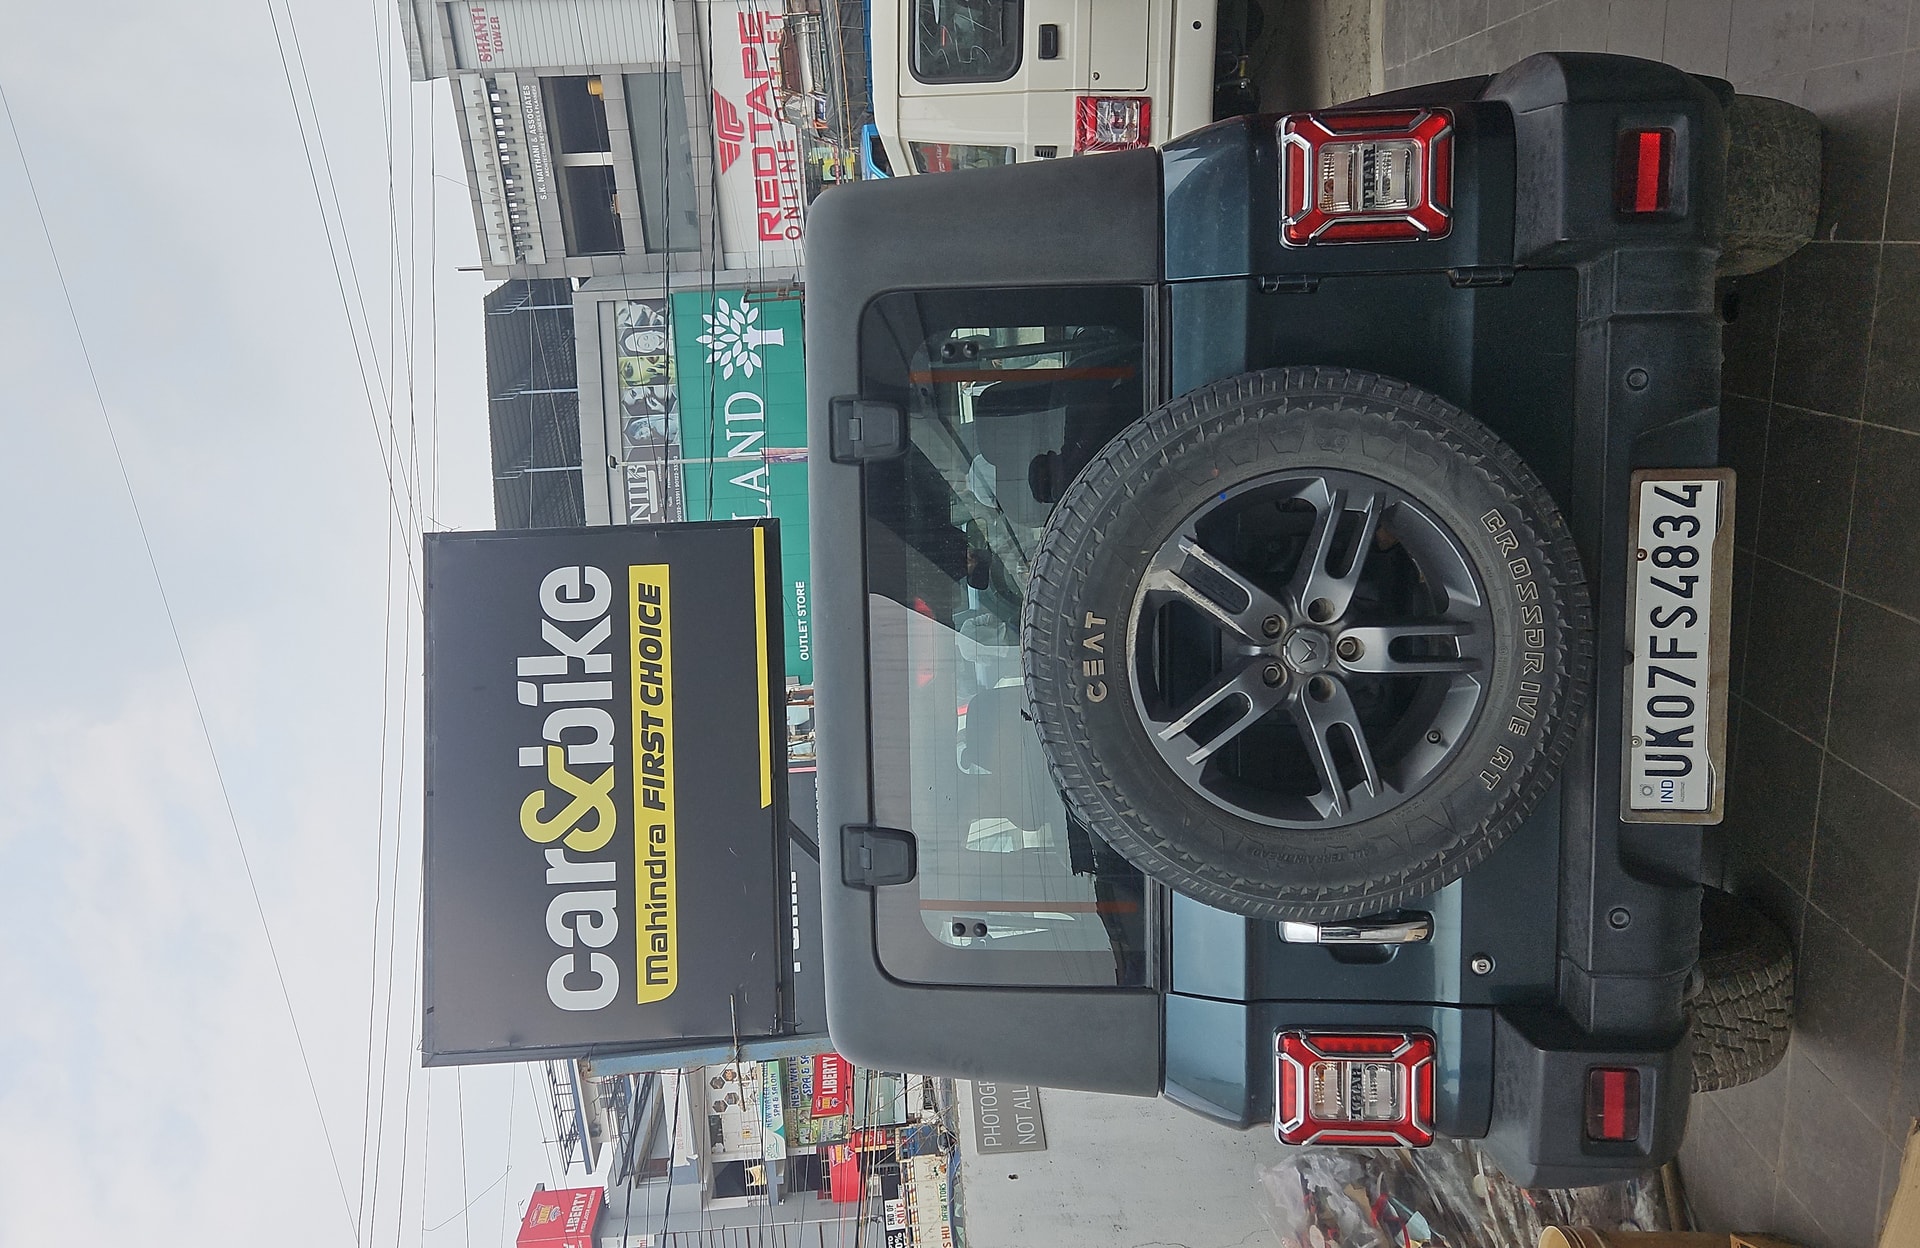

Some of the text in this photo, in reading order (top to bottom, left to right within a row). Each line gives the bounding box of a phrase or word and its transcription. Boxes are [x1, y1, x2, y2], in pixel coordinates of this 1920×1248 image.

[471, 8, 492, 62] SHANTI
[490, 16, 504, 54] TOWER
[522, 85, 537, 134] ASSOCIATES
[532, 144, 545, 182] NAITHANI
[541, 143, 550, 177] ARCHITECTURE
[1363, 148, 1376, 208] THAR
[538, 184, 548, 200] S.K.
[777, 140, 802, 240] ONLINE
[724, 392, 772, 520] LAND
[626, 464, 651, 523] NIIB
[796, 581, 809, 660] OUTLET STORE
[1644, 484, 1702, 778] UK07FS4834
[1082, 611, 1108, 702] CEAT
[1479, 509, 1545, 791] CROSSDRIVE AT
[638, 582, 669, 985] Mahindra FIRST CHOICE
[1660, 779, 1673, 803] IND
[770, 1073, 778, 1095] SALON
[802, 1077, 813, 1094] SPA
[822, 1056, 838, 1094] LIBERTY
[772, 1104, 780, 1116] SPA
[790, 1086, 800, 1106] NEW
[765, 1110, 773, 1128] NEW
[1015, 1114, 1037, 1144] NOT
[564, 1192, 588, 1232] LIBERTY
[886, 1214, 894, 1225] END
